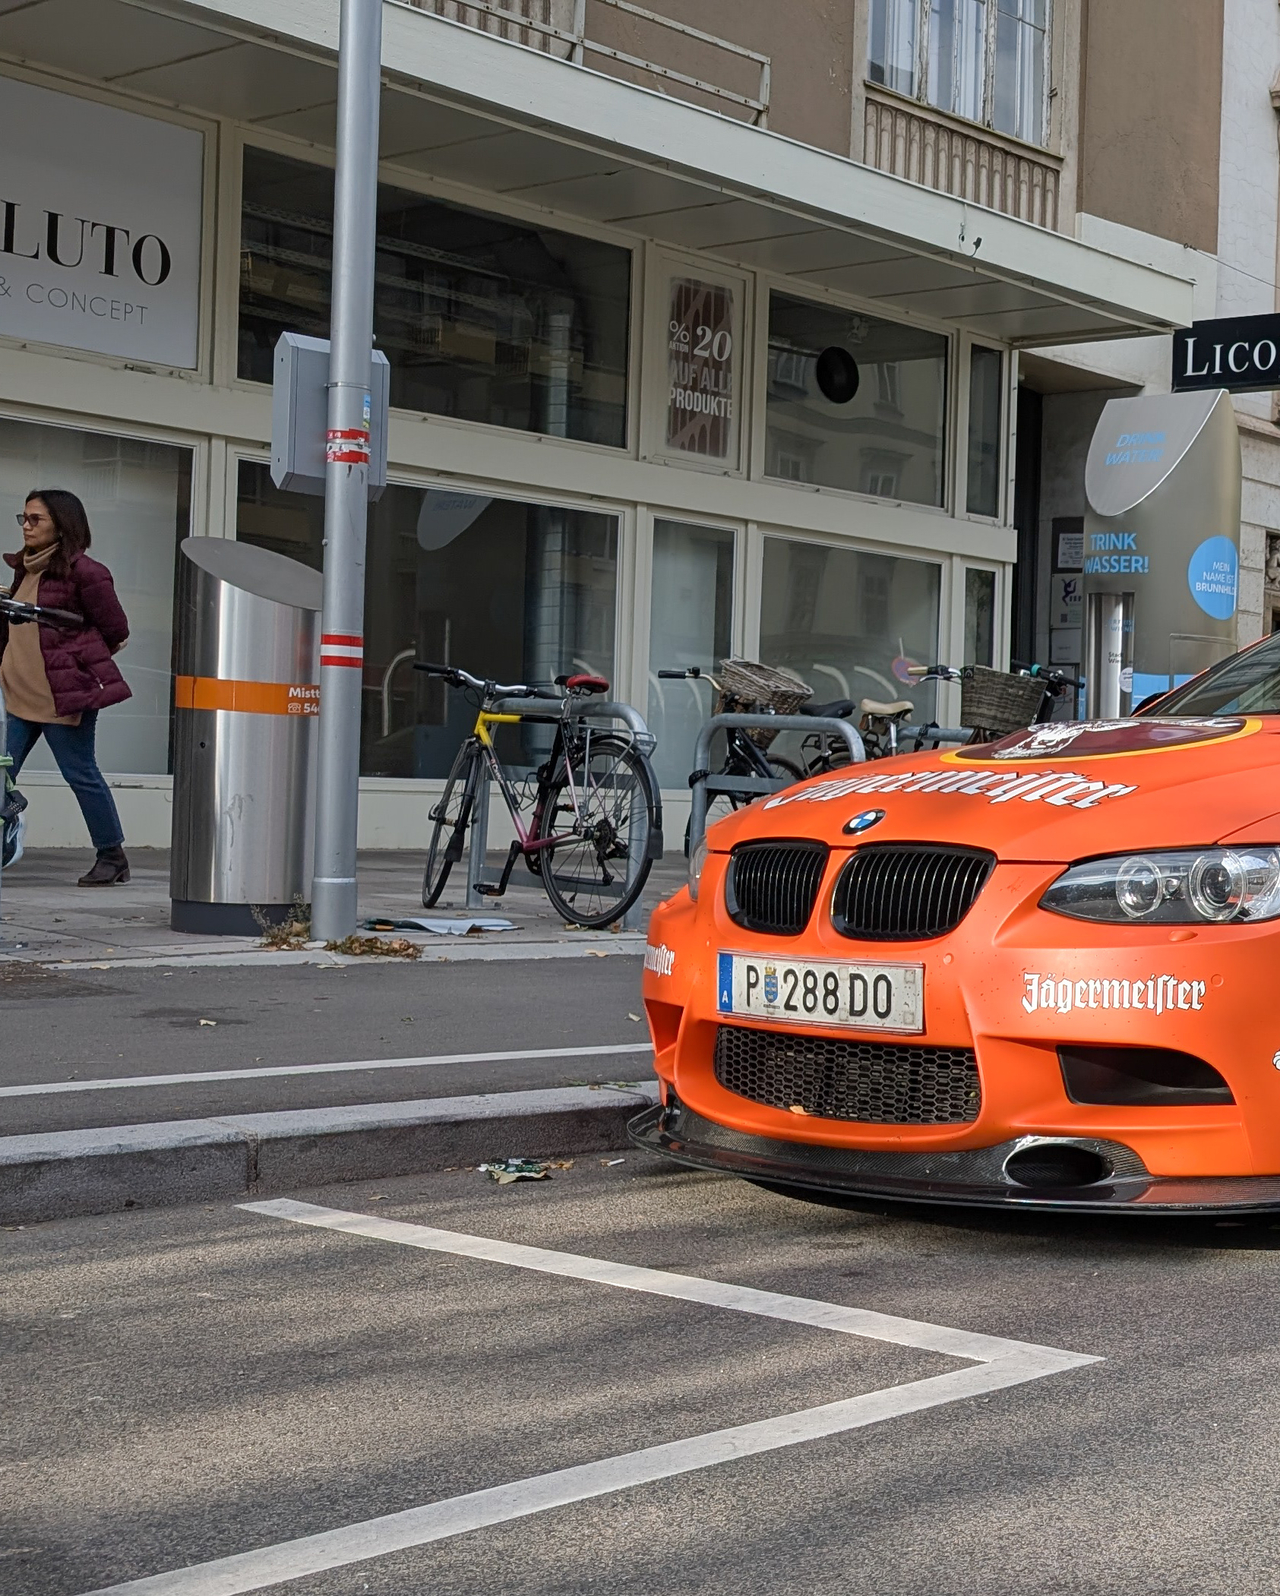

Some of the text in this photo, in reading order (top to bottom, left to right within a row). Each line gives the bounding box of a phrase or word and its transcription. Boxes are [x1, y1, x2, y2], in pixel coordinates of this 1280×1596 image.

[26, 283, 148, 324] CONCEPT
[693, 325, 732, 362] 20
[670, 358, 698, 386] AUF
[668, 387, 732, 419] PRODUKTE
[1090, 533, 1137, 551] TRINK
[1084, 555, 1149, 574] WASSER!
[1212, 561, 1230, 572] MEIN
[1202, 571, 1225, 583] NAME
[721, 990, 729, 1004] A
[746, 965, 893, 1019] P 288 DO
